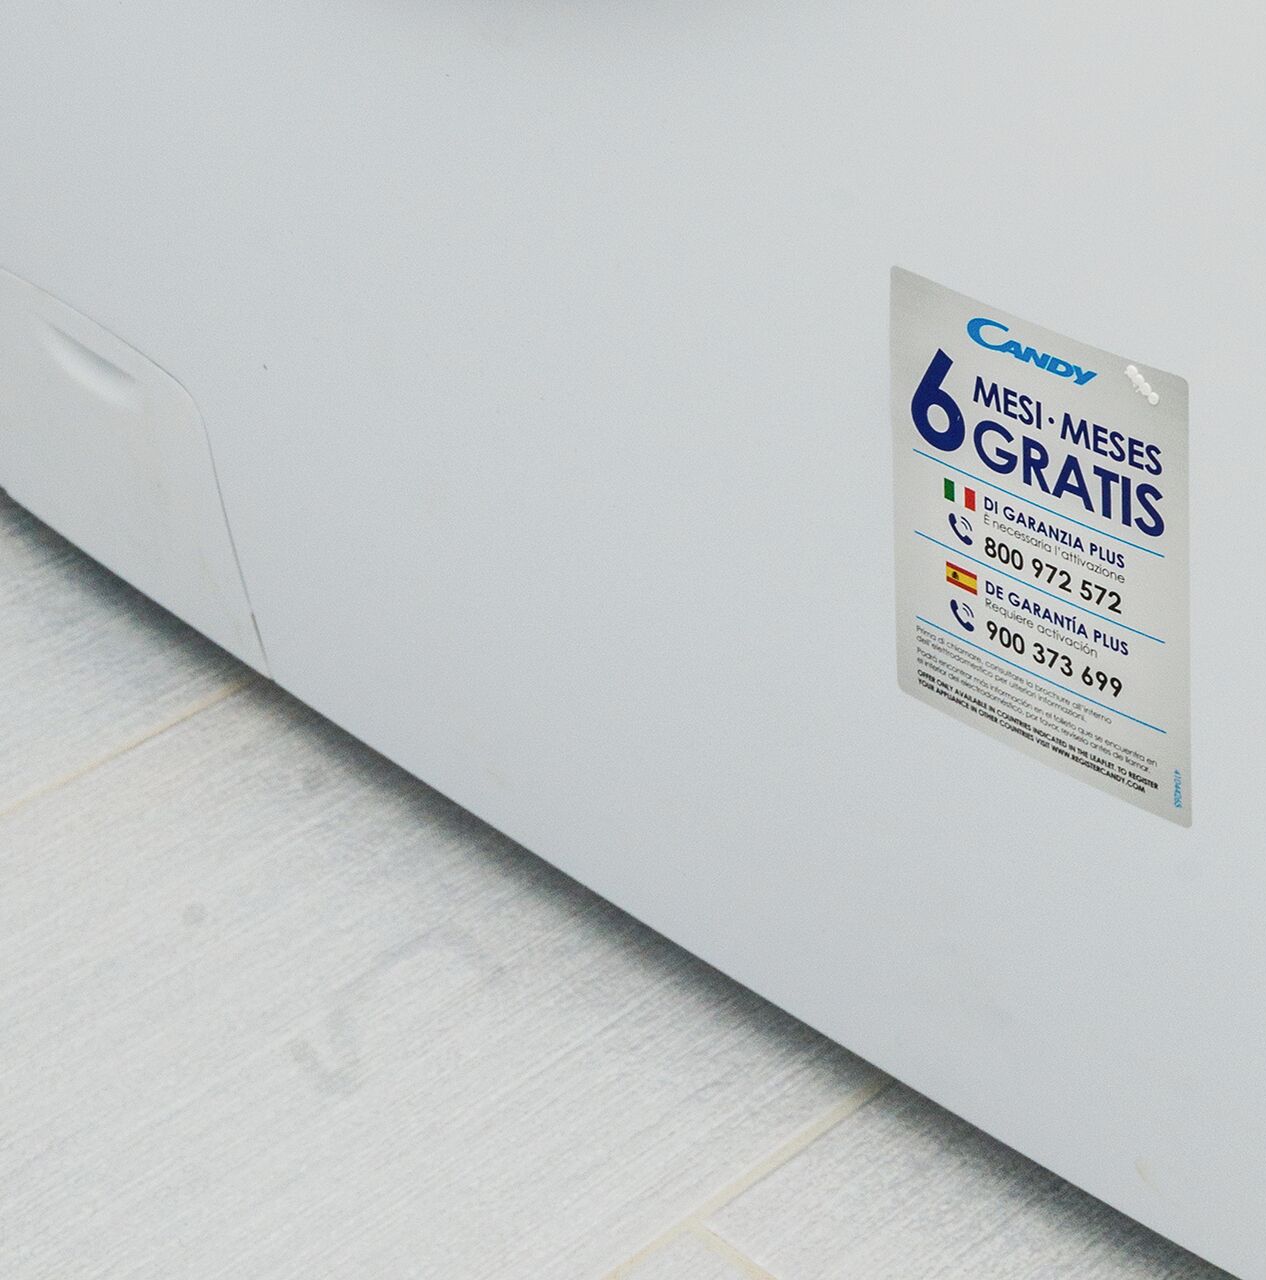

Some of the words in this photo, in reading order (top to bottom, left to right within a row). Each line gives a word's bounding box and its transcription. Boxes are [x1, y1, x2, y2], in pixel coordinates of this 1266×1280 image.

[966, 317, 1098, 385] CANDY
[911, 348, 965, 452] 6
[972, 376, 1042, 430] MESI
[1060, 413, 1163, 476] MESES
[973, 420, 1165, 538] GRATIS
[984, 496, 998, 514] DI
[1003, 506, 1084, 553] GARANZIA
[1090, 542, 1125, 569] PLUS
[993, 520, 1052, 553] necessaria
[984, 537, 1024, 571] 800
[1032, 558, 1072, 593] 972
[1080, 579, 1122, 614] 572
[985, 580, 1004, 601] DE
[1008, 592, 1088, 639] GARANTÍA
[1094, 630, 1129, 656] PLUS
[985, 598, 1034, 630] Requiere
[1037, 624, 1098, 658] activación
[986, 620, 1025, 655] 900
[1032, 642, 1073, 678] 373
[1081, 666, 1123, 698] 699
